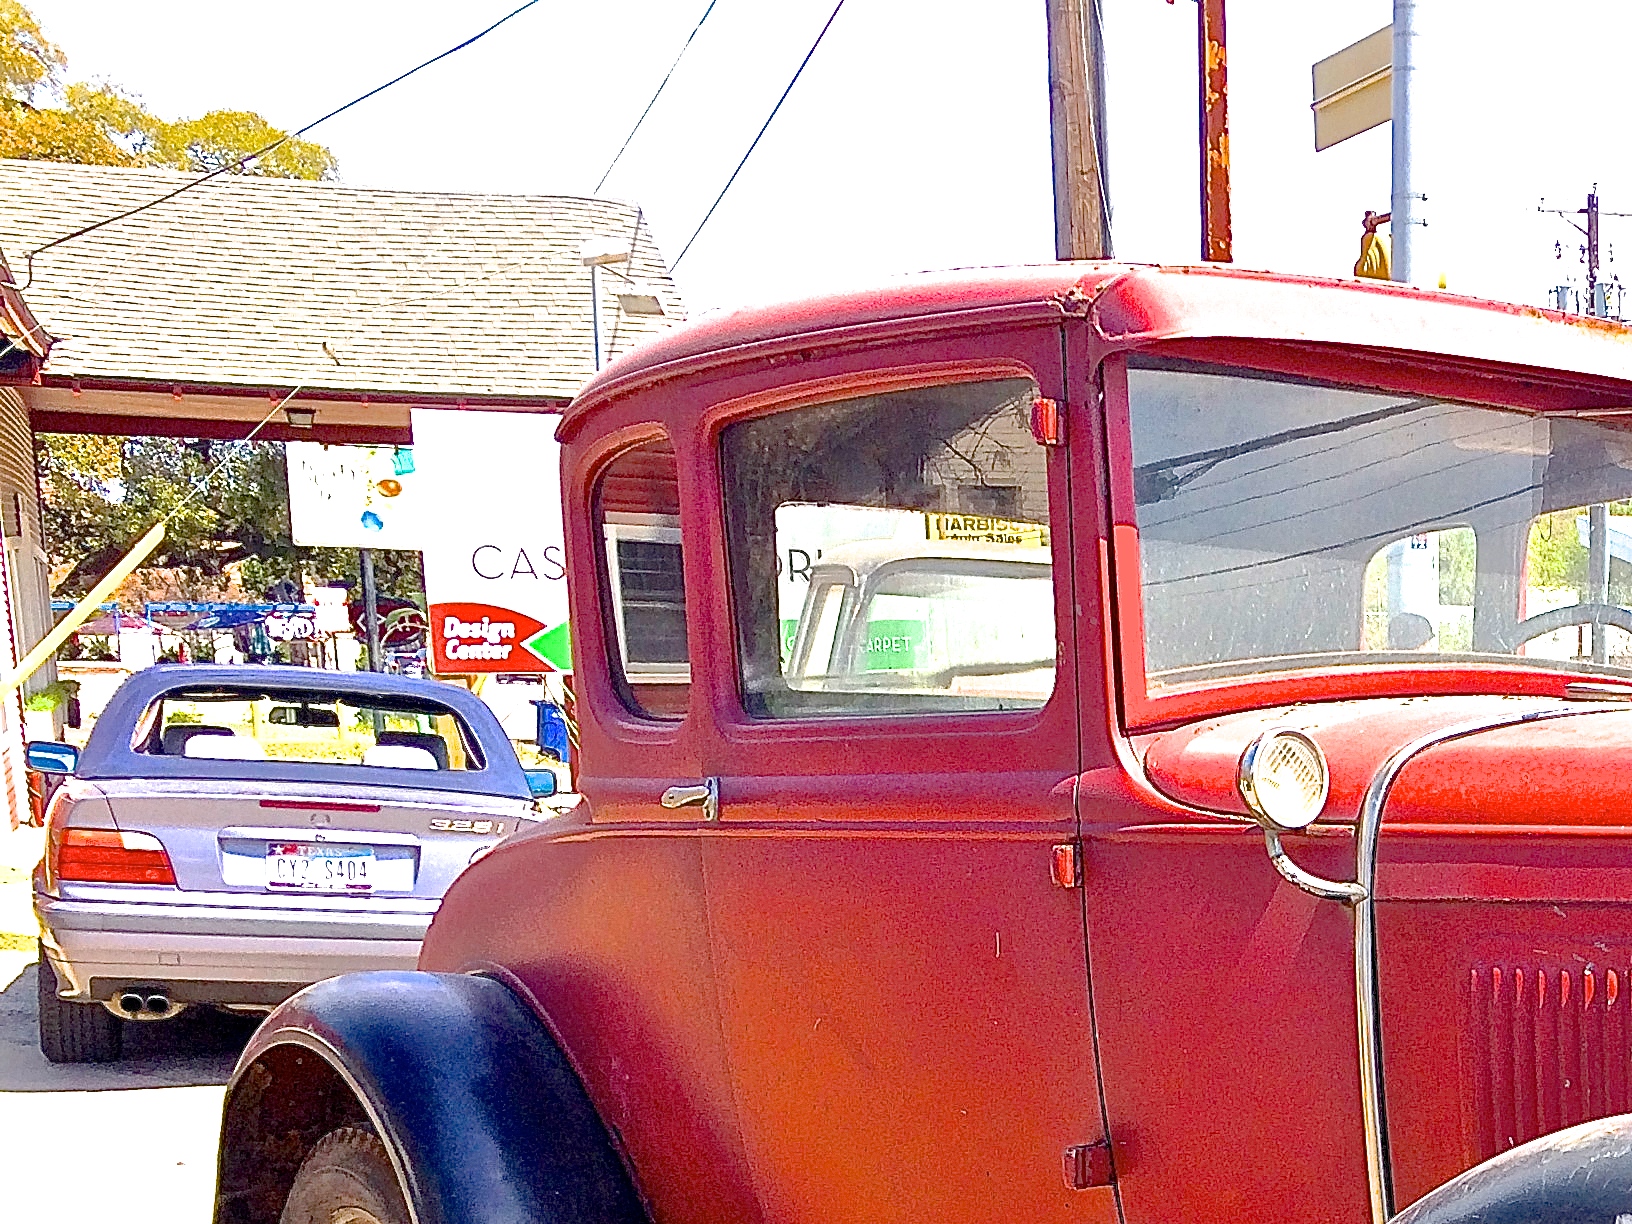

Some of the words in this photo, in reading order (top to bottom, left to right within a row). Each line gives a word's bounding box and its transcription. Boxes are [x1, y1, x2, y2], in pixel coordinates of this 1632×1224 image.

[443, 616, 516, 644] Design
[445, 638, 513, 660] Center
[298, 845, 342, 857] TEXAS
